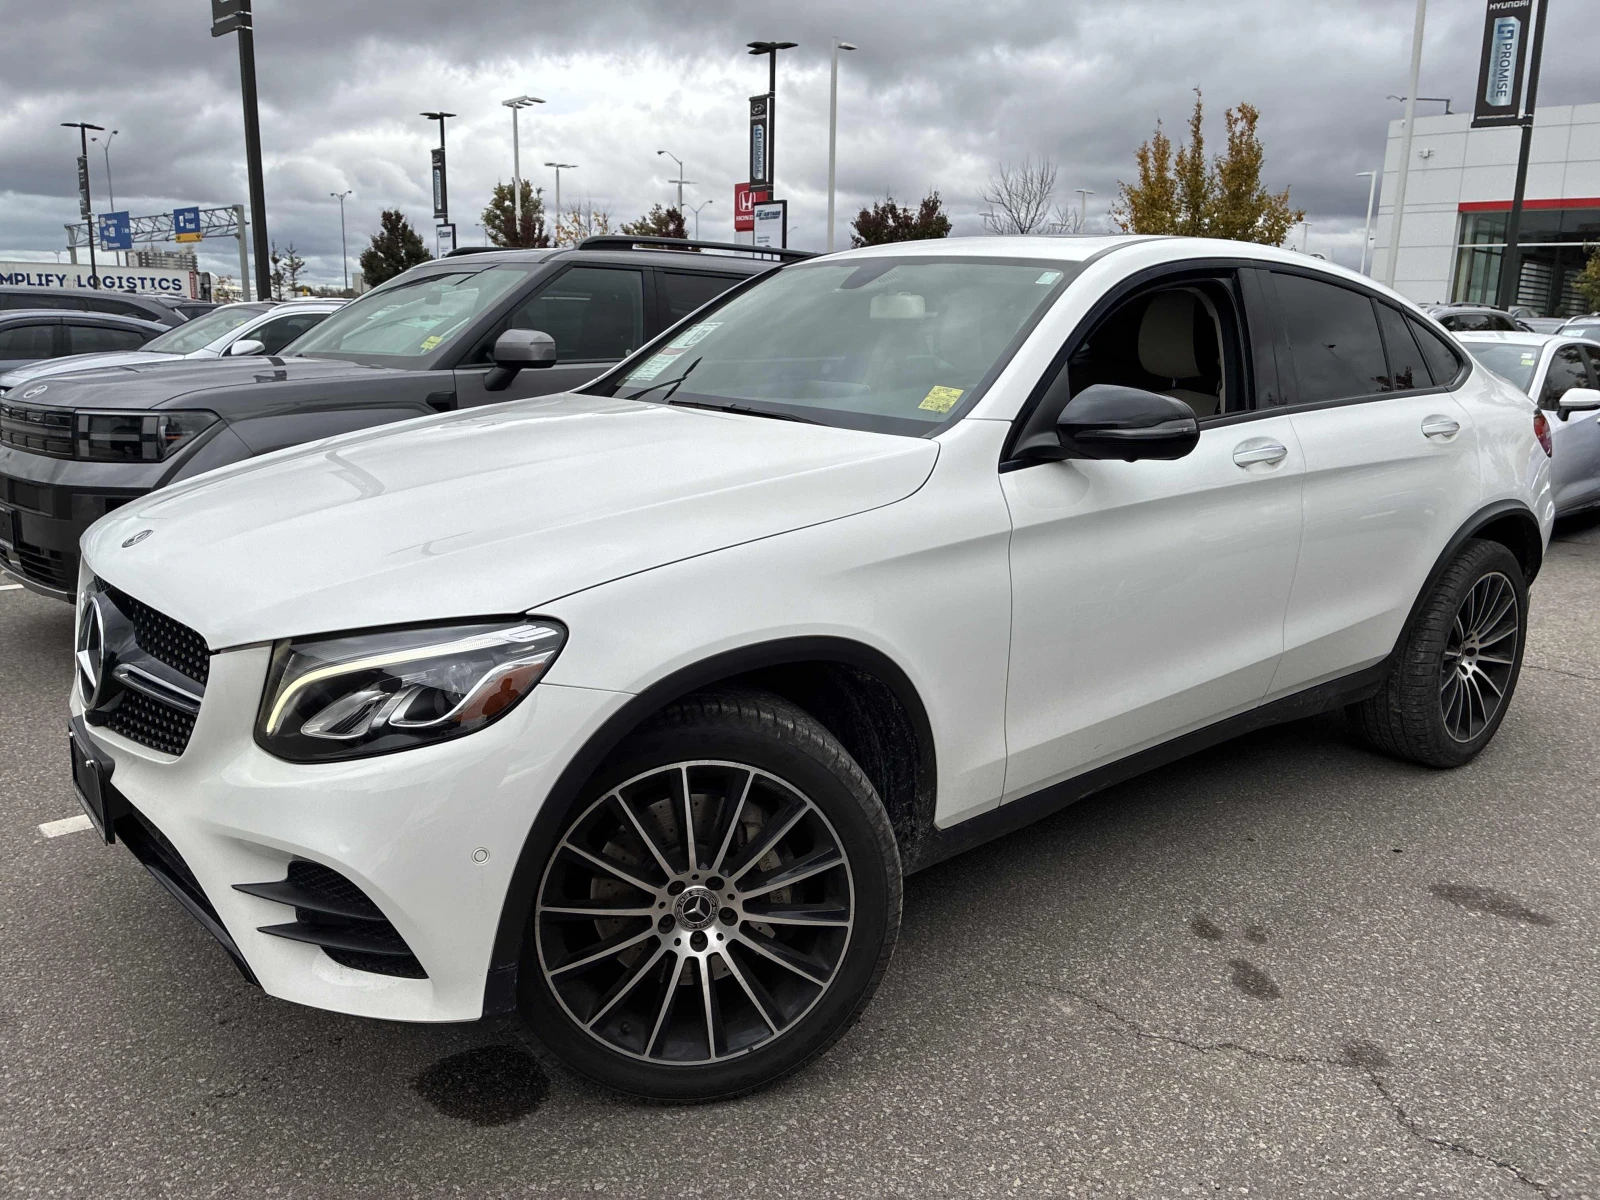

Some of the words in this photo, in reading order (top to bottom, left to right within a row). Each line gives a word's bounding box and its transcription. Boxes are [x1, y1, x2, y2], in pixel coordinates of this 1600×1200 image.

[1489, 0, 1530, 10] HYUNDAI
[1496, 43, 1512, 97] PROMISE
[77, 274, 182, 291] LOGISTICS
